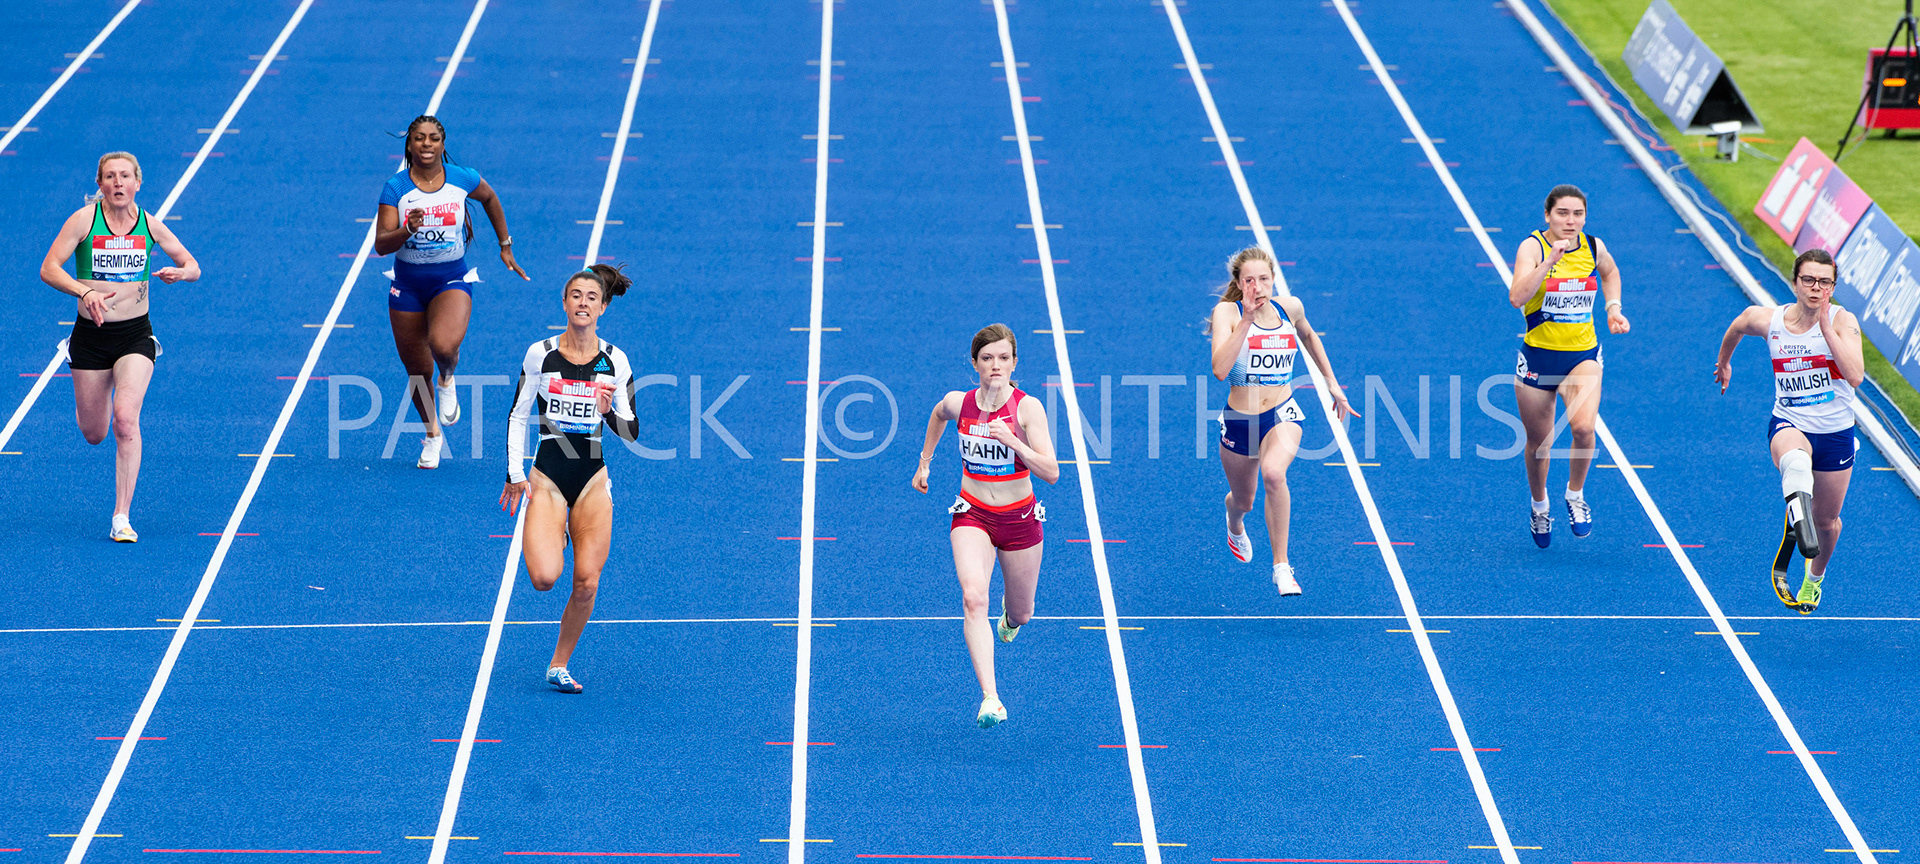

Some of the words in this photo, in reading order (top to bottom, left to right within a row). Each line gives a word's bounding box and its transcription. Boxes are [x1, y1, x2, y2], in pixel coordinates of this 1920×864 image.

[423, 214, 444, 226] üller
[105, 236, 134, 248] müller
[414, 230, 445, 243] COX
[93, 254, 145, 268] HERMITAGE
[1558, 278, 1587, 292] müller
[1544, 295, 1593, 308] WALSH-DANN
[1261, 335, 1290, 348] müller
[1251, 354, 1294, 368] DOWN
[1783, 358, 1813, 372] müller
[562, 382, 596, 396] müller
[1778, 372, 1830, 392] KAMLISH
[1286, 406, 1298, 420] 3
[962, 439, 1008, 460] HAHN
